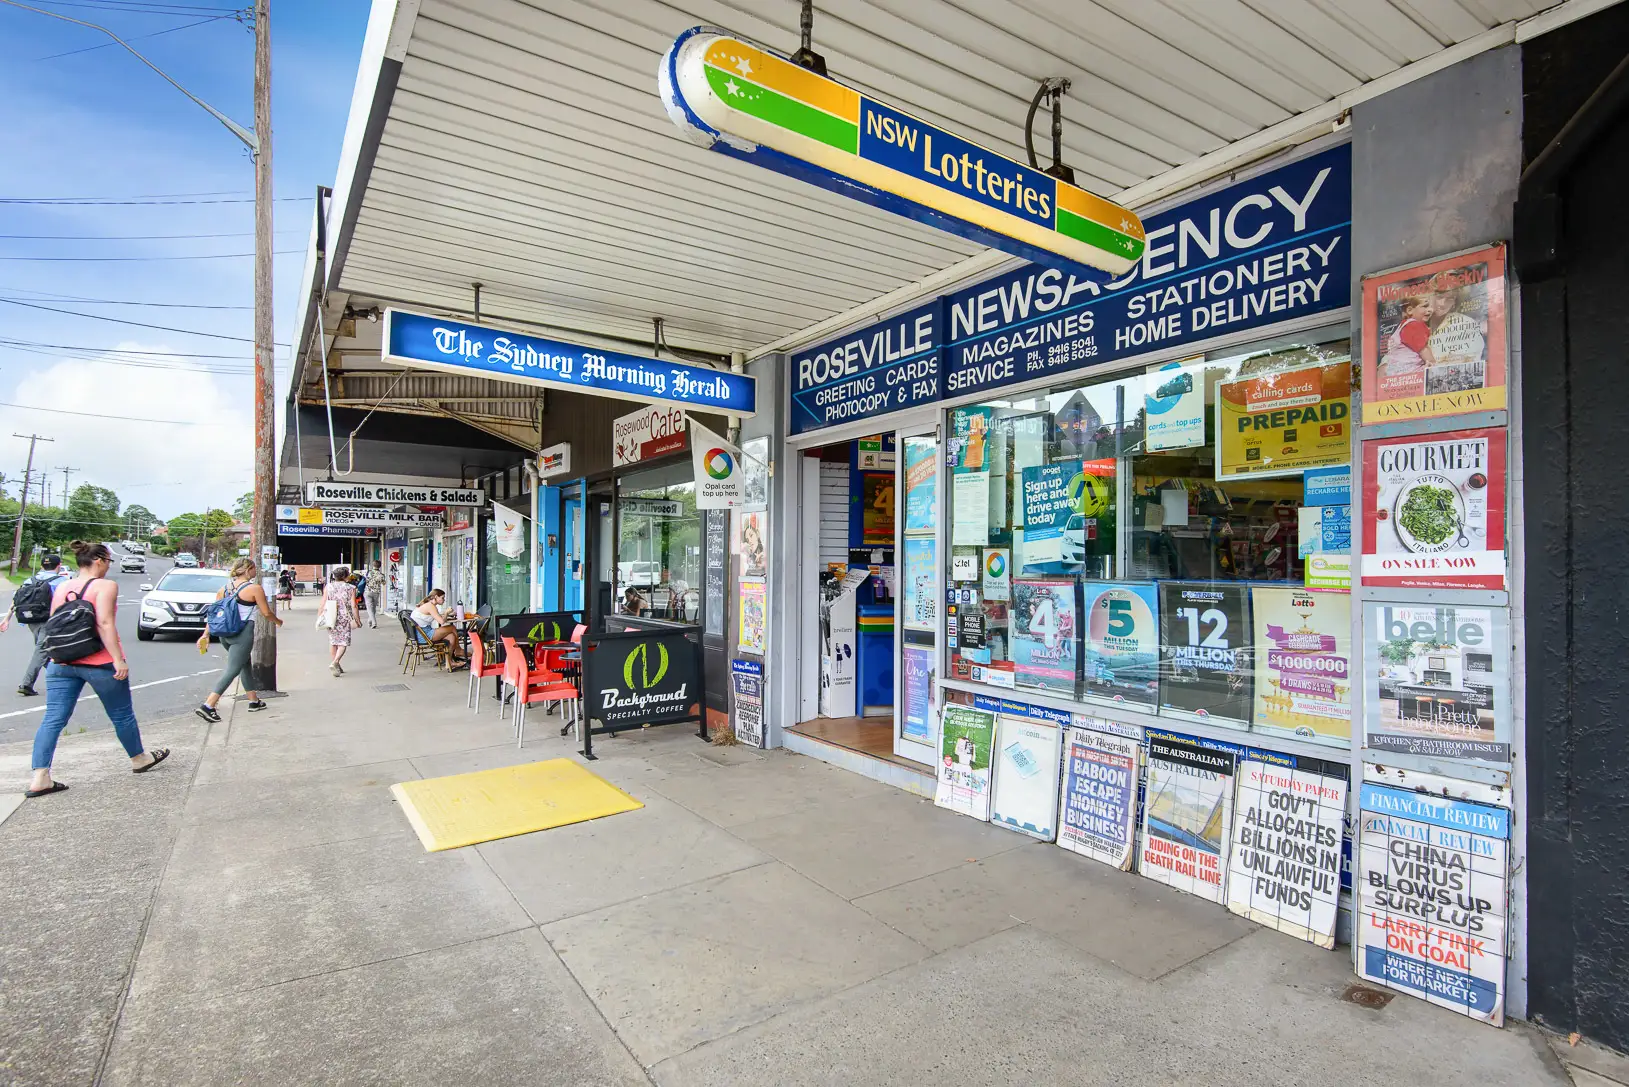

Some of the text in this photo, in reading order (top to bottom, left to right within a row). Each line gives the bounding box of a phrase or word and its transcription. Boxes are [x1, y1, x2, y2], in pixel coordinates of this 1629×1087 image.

[866, 109, 1051, 220] NSW Lotteries
[963, 236, 1342, 366] MAGAZINES STATIONERY
[1115, 273, 1330, 350] HOME DELIVERY
[432, 326, 731, 400] The Sydney Morning Herald
[799, 313, 934, 391] ROSEVILLE
[1026, 336, 1095, 363] PH. 9416 5041
[1026, 345, 1099, 373] FAX 9416 5052
[815, 356, 938, 407] GREETING CARDS
[825, 359, 1015, 422] PHOTOCOPY & FAX SERVICE
[1251, 383, 1313, 401] calling cards
[1390, 378, 1424, 387] AUSTRALIA
[1237, 401, 1348, 433] PREPAID
[1377, 393, 1485, 417] ON SALE NOW
[615, 407, 682, 440] Rosewood Cafe
[1148, 417, 1202, 431] cards top ups
[1042, 466, 1061, 475] goget
[1380, 442, 1485, 473] GOURMET
[316, 485, 478, 503] Roseville Chickens & Salads
[704, 483, 720, 491] Opal
[1025, 477, 1062, 494] Sign up
[1306, 487, 1340, 495] RECHARGE
[1416, 476, 1444, 485] TUTTO
[1026, 485, 1070, 504] here and
[1026, 497, 1081, 515] drive away
[325, 510, 386, 521] ROSEVILLE
[388, 513, 415, 522] MILK
[418, 515, 440, 523] BAR
[1027, 513, 1056, 526] today
[282, 525, 362, 536] Roseville Pharmacy
[1413, 541, 1449, 554] ITALIANO
[1382, 557, 1477, 570] ON SALE NOW
[1292, 599, 1315, 608] Lotto
[1101, 598, 1135, 638] $5
[1176, 606, 1229, 649] $12
[1384, 606, 1485, 646] belle
[1030, 649, 1060, 660] MILLION
[1103, 636, 1139, 647] MILLION
[1176, 646, 1232, 663] MILLION
[1176, 658, 1235, 672] THIS THURSDAY
[1270, 653, 1345, 674] $1,000,000
[600, 683, 688, 710] Background
[606, 704, 684, 721] SPECIALTY COFFEE
[1030, 707, 1071, 723] Daily Telegraph
[1075, 720, 1105, 730] AUSTRALIAN
[1399, 709, 1482, 736] handsome
[1437, 705, 1481, 726] Pretty
[1075, 731, 1131, 754] Daily Telegraph
[1107, 725, 1140, 737] AUSTRALIAN
[1373, 735, 1413, 746] KITCHEN
[1422, 739, 1474, 751] BATHROOM
[1474, 744, 1503, 753] ISSUE
[1152, 744, 1224, 767] THE AUSTRALIAN
[1409, 745, 1463, 757] ON SALE NOW
[1074, 758, 1127, 788] BABOON
[1150, 759, 1217, 782] AUSTRALIAN
[1076, 776, 1122, 804] ESCAPE
[1251, 771, 1339, 800] SATURDAY PAPER
[1070, 792, 1125, 823] MONKEY
[1268, 789, 1318, 818] GOV'T
[1371, 792, 1501, 833] FINANCIAL REVIEW
[1067, 808, 1125, 841] BUSINESS
[1245, 806, 1337, 848] ALLOCATES
[1365, 817, 1496, 857] FINANCIAL REVIEW
[1149, 837, 1218, 870] RIDING ON THE
[1240, 826, 1338, 873] BILLIONS IN
[1390, 839, 1467, 874] CHINA
[1144, 850, 1222, 887] DEATH RAIL LINE
[1391, 857, 1465, 892] VIRUS
[1255, 876, 1312, 912] FUNDS
[1368, 870, 1492, 918] BLOWS UP
[1374, 890, 1485, 933] SURPLUS
[1371, 912, 1485, 958] LARRY FINK
[1386, 933, 1472, 972] ON COAL
[1382, 964, 1478, 1005] FOR MARKETS
[1386, 954, 1474, 989] WHERE NEXT
